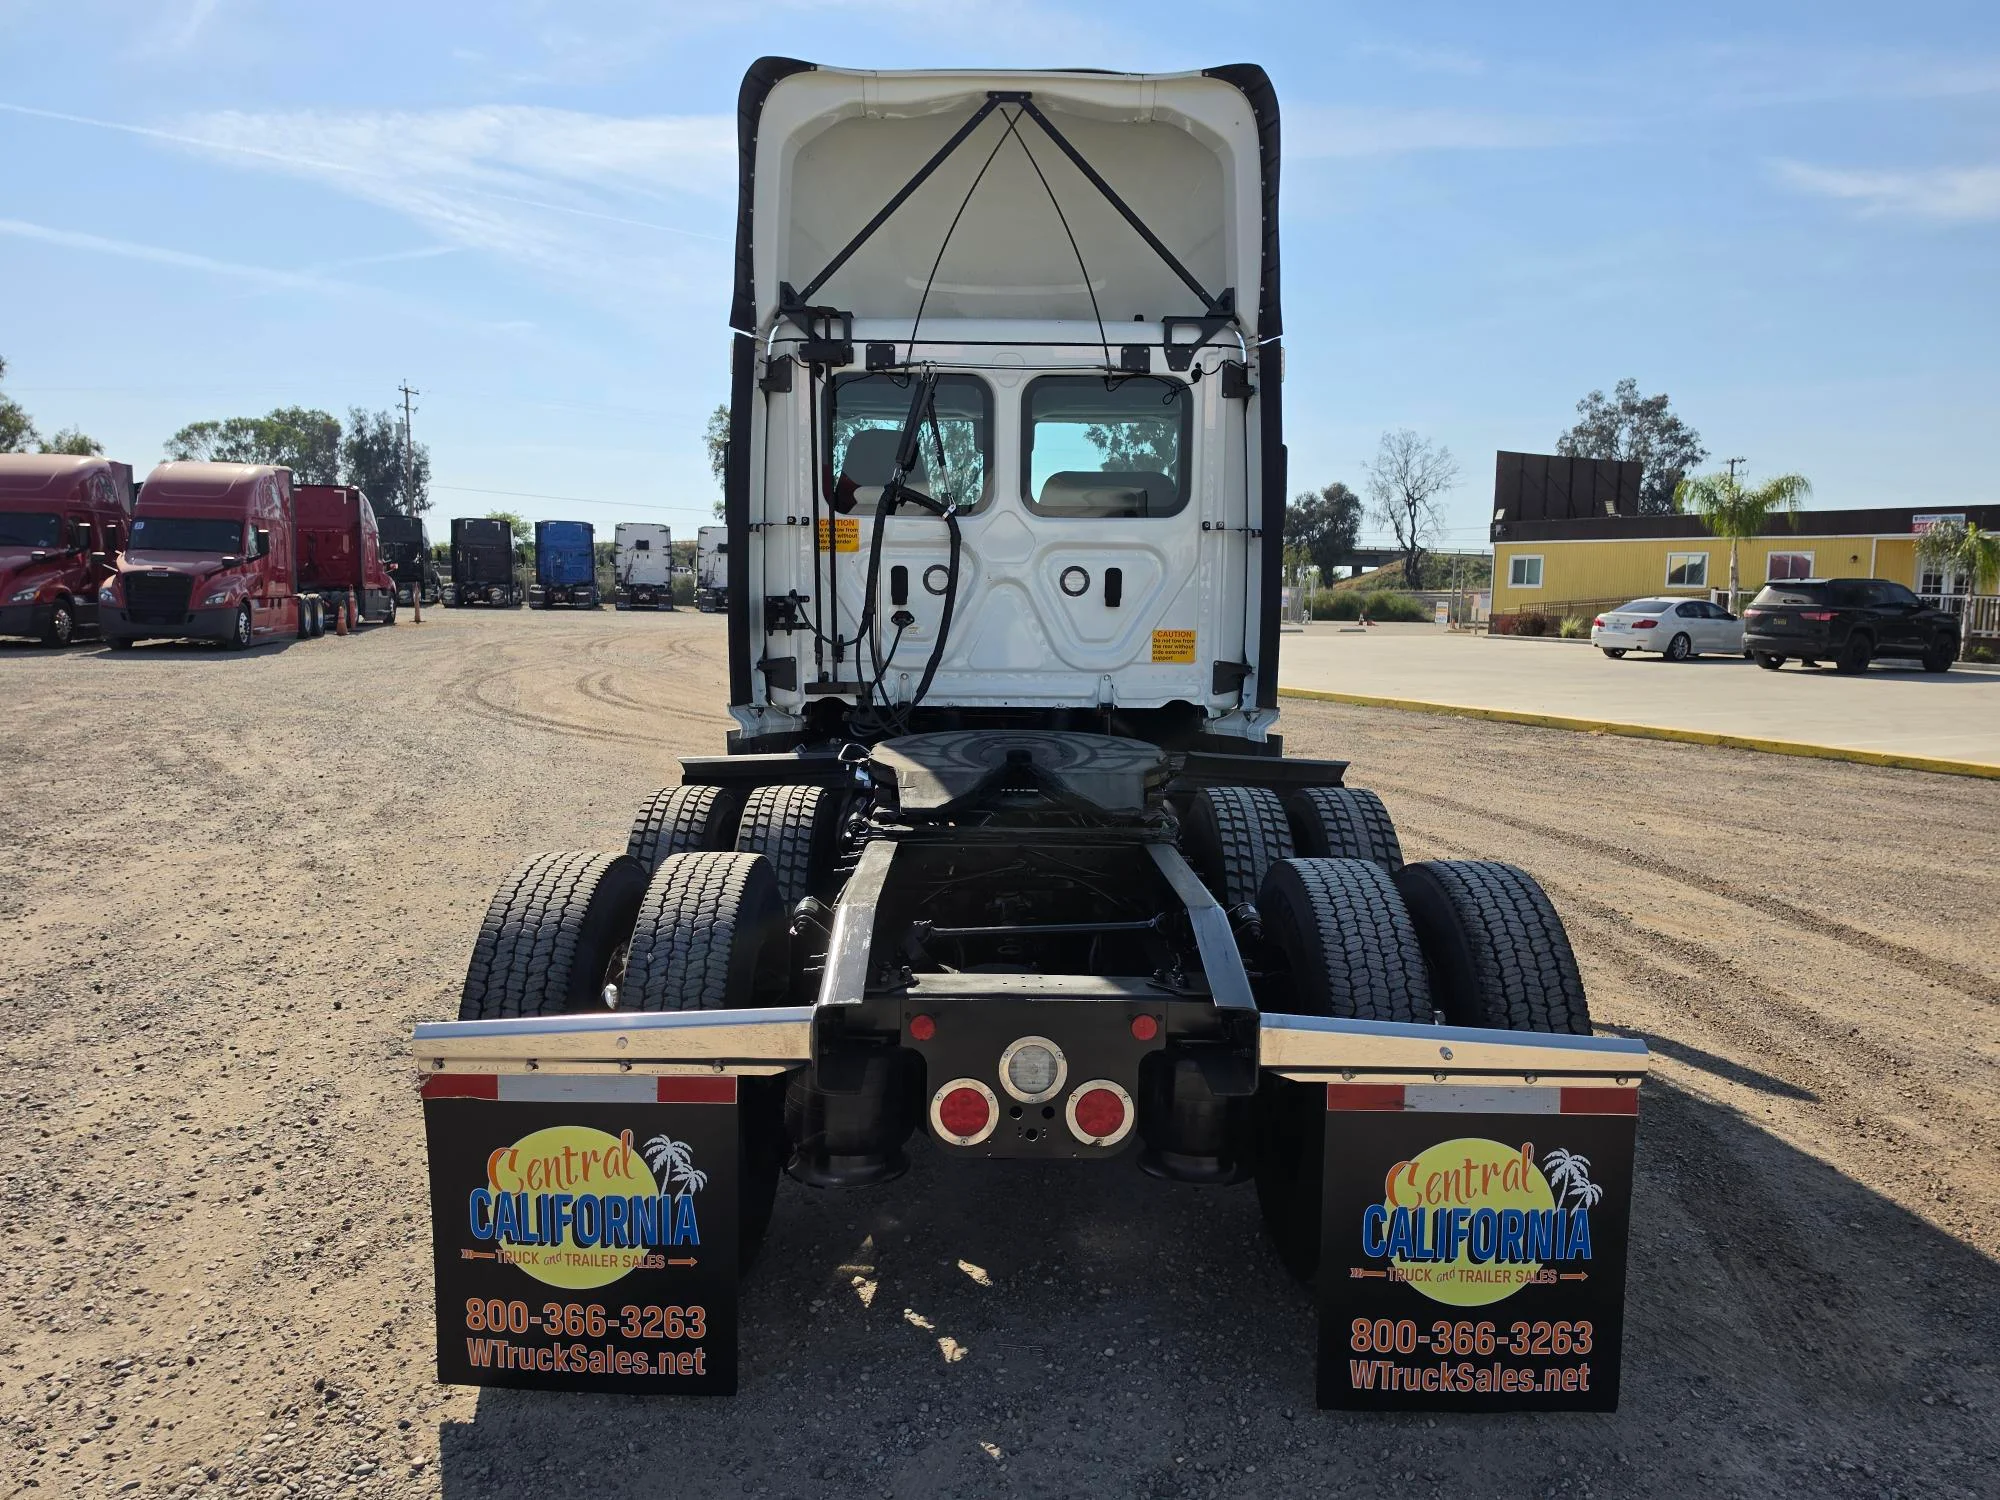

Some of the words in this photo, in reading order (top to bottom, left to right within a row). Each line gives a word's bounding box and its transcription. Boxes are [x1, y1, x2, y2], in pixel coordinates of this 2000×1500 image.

[487, 1129, 635, 1195] Central
[1385, 1142, 1534, 1211] Central
[469, 1187, 700, 1249] CALIFORNIA
[1362, 1204, 1592, 1264] CALIFORNIA
[496, 1250, 540, 1265] TRUCK
[544, 1252, 562, 1265] and
[565, 1253, 618, 1268] TRAILER
[622, 1254, 665, 1269] SALES
[1386, 1267, 1432, 1282] TRUCK
[1436, 1267, 1456, 1283] and
[1459, 1269, 1512, 1283] TRAILER
[1515, 1269, 1557, 1284] SALES
[465, 1298, 706, 1338] 800-366-3263
[1350, 1318, 1593, 1355] 800-366-3263
[467, 1338, 706, 1375] WTruckSales.net
[1350, 1360, 1590, 1392] WTruckSales.net
